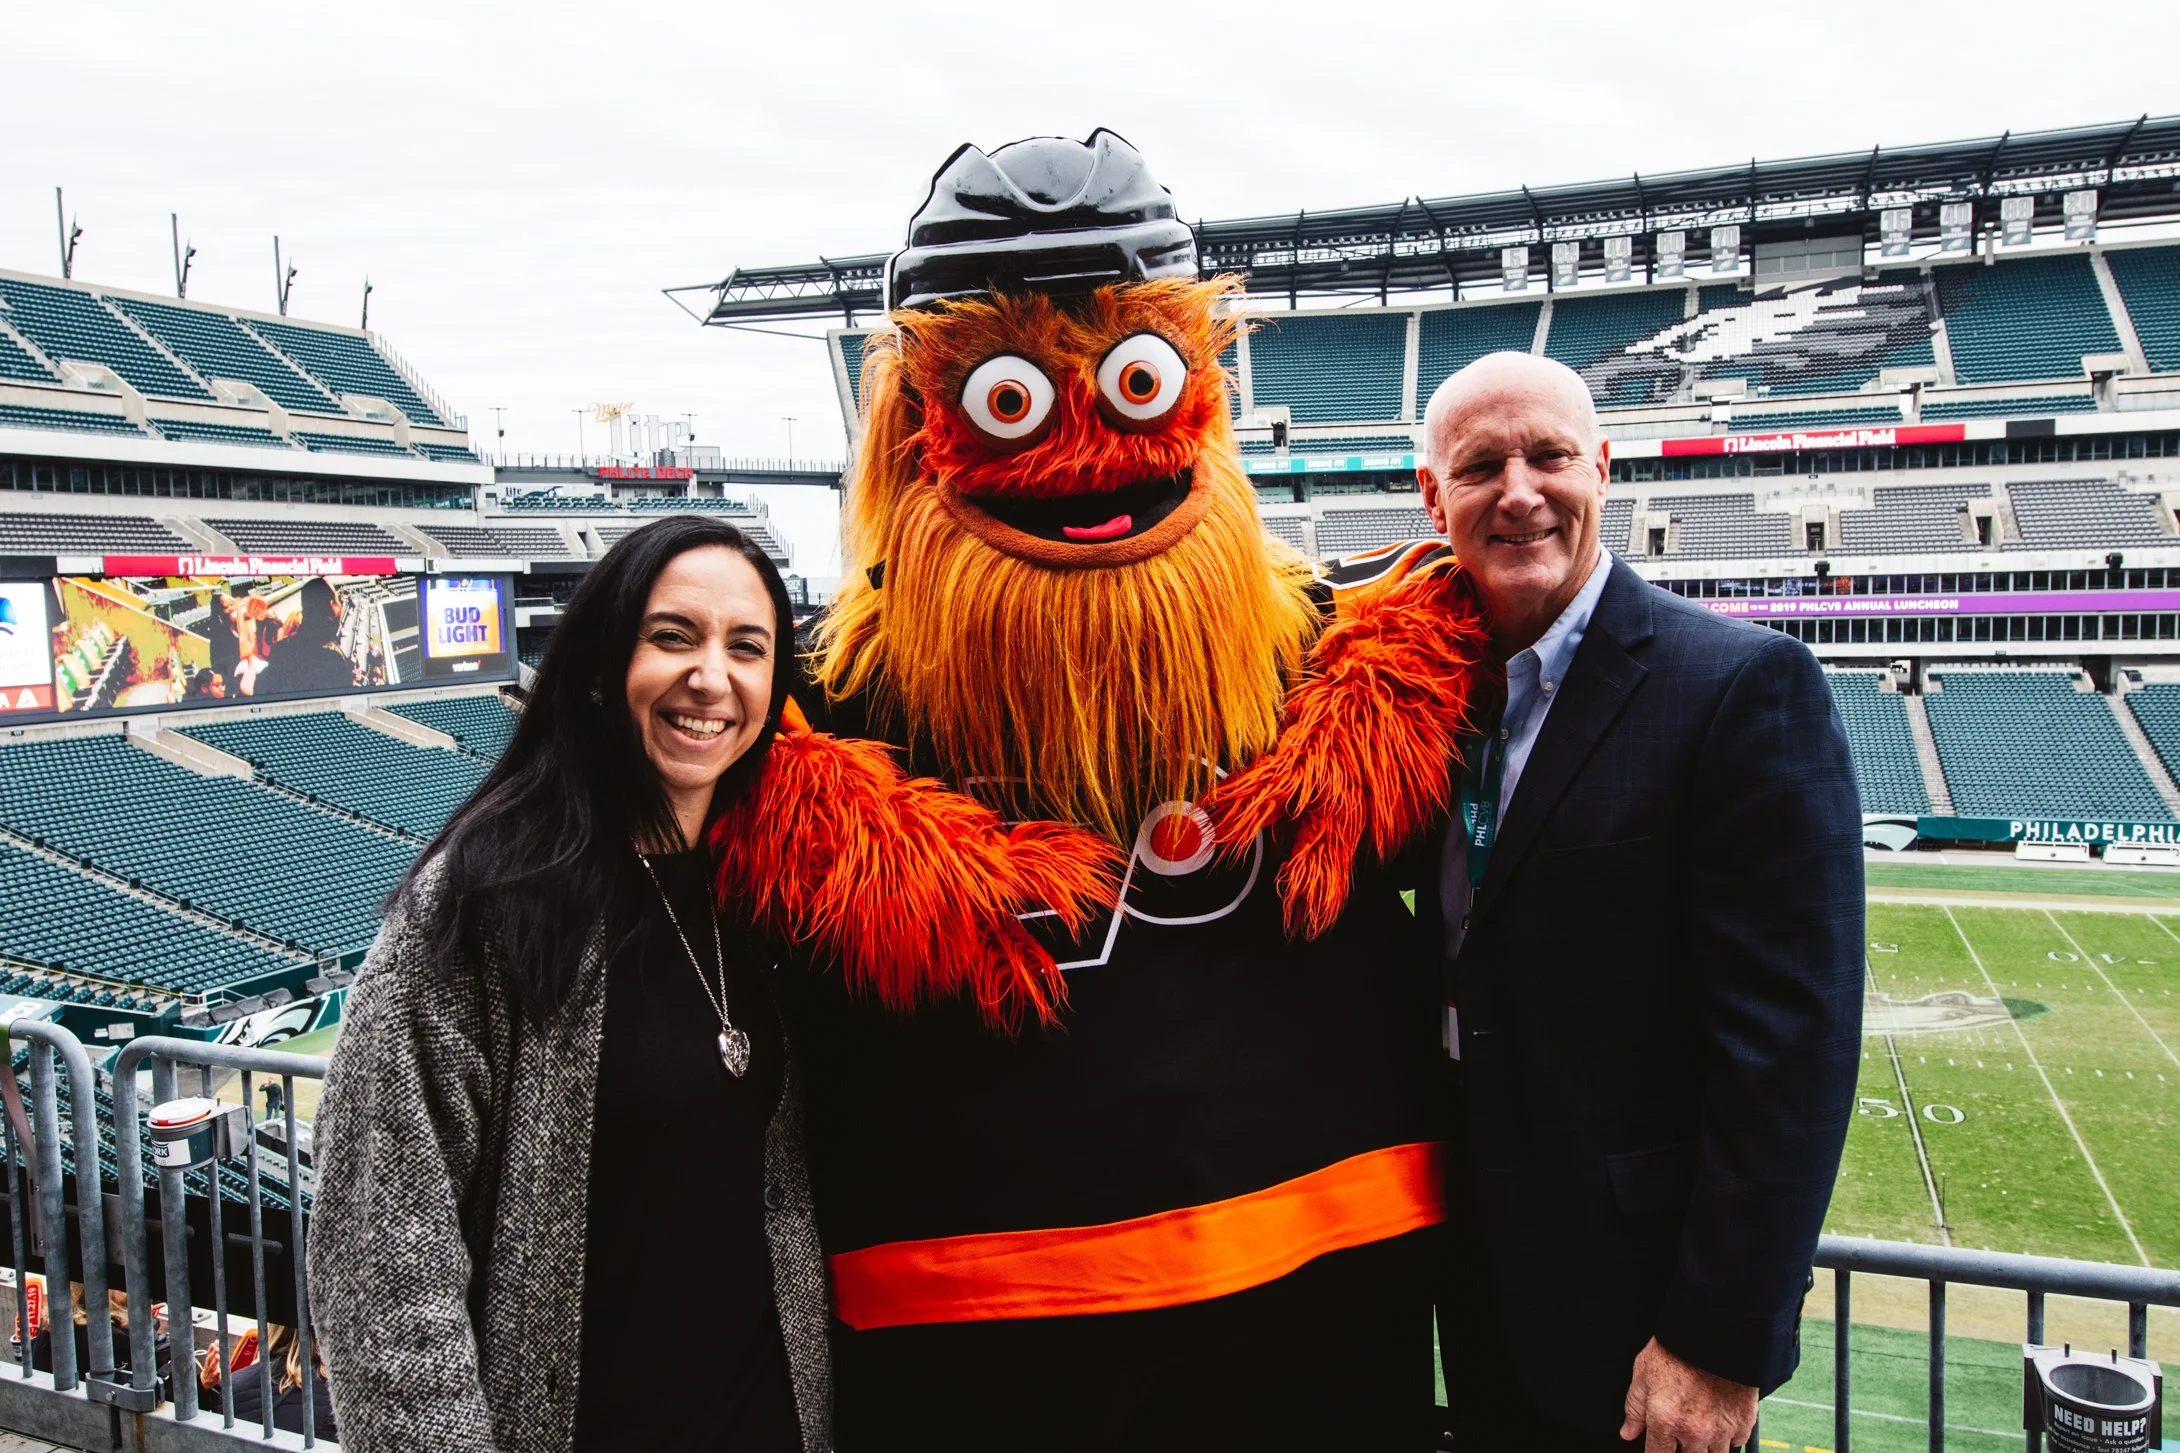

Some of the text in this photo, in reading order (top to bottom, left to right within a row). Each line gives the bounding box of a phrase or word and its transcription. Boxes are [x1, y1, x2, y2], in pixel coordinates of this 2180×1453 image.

[607, 413, 692, 465] Lite
[1739, 429, 1896, 452] Lincoln Financial Field
[656, 465, 694, 479] DECK
[195, 556, 343, 575] Lincoln Financial Field
[443, 607, 481, 625] BUD
[1769, 602, 1797, 613] 2019
[1799, 601, 1842, 613] PHLCVB
[1844, 600, 1892, 612] ANNUAL
[1893, 599, 1959, 611] LUNCHEON
[438, 625, 488, 643] LIGHT
[1474, 800, 1490, 847] PHLCVB
[2010, 821, 2180, 842] PHILADELPHI
[2054, 1403, 2147, 1437] NEED HELP?
